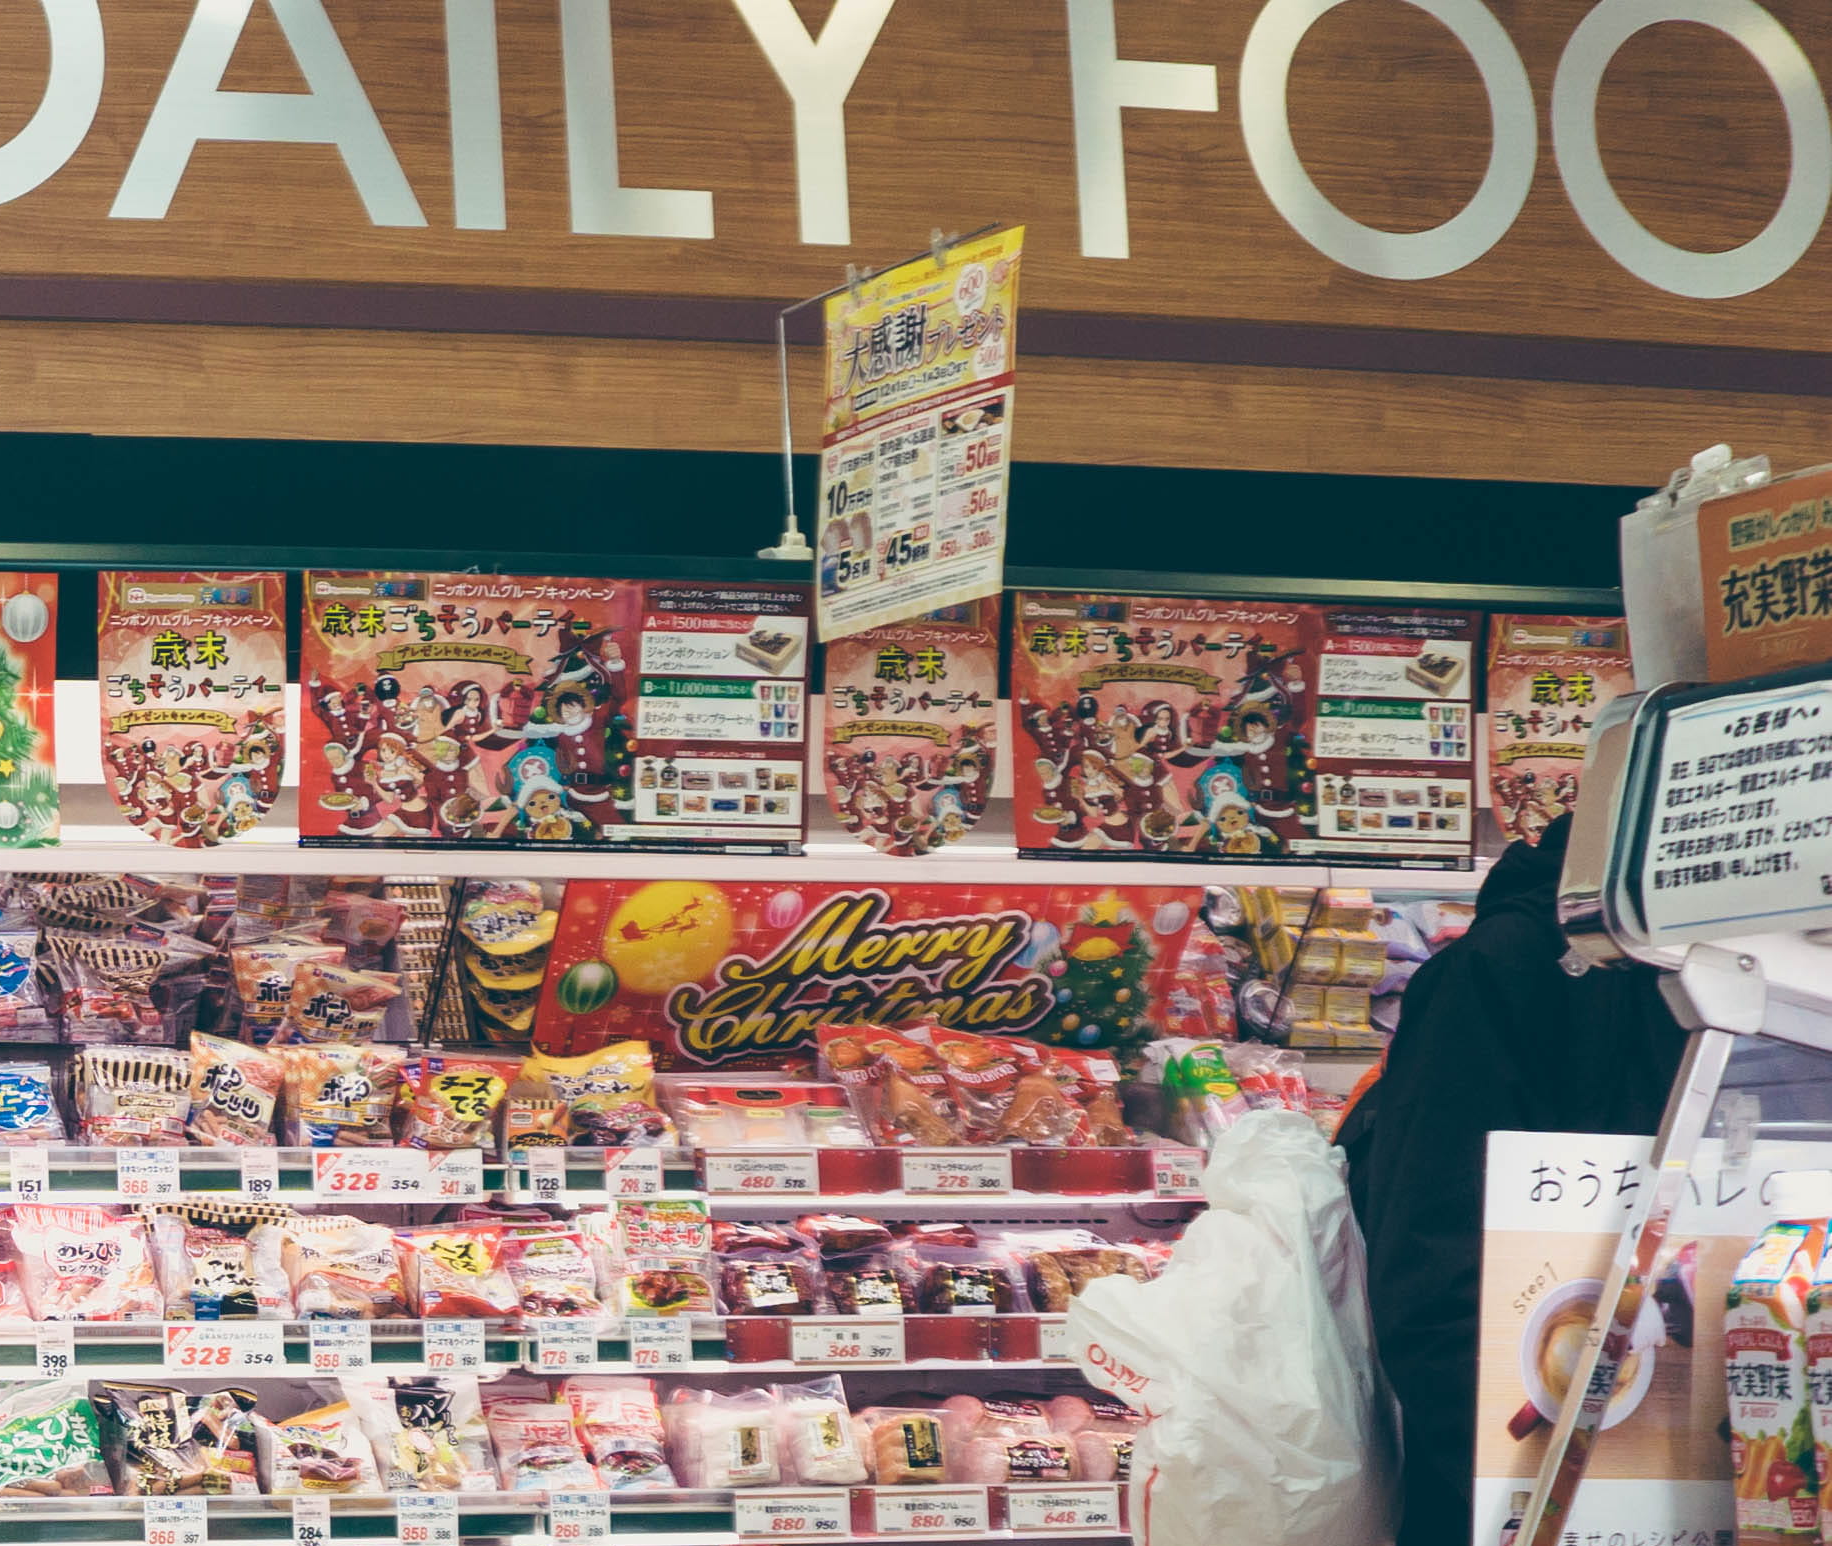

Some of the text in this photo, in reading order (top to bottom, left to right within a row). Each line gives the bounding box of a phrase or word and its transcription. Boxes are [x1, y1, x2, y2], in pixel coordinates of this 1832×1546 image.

[433, 583, 616, 601] ニッポンハムグループキャンペーン
[321, 602, 592, 641] 歳末ごちそうパーティー
[151, 630, 228, 671] 歳末
[1027, 622, 1278, 664] 歳末ごちそうパーティー
[873, 644, 947, 685] 歳末
[106, 676, 281, 701] ごちそうパーティー
[1529, 671, 1595, 707] 歳末
[831, 688, 994, 717] ごちそうパーティー
[731, 901, 1017, 989] Merry
[17, 1179, 42, 1194] 151
[247, 1178, 273, 1193] 189
[328, 1171, 382, 1193] 328
[41, 1354, 68, 1368] 398
[180, 1345, 274, 1367] 328 354
[428, 1350, 455, 1367] 178
[827, 1343, 862, 1359] 368
[771, 1517, 806, 1531] 880
[1043, 1510, 1077, 1524] 648
